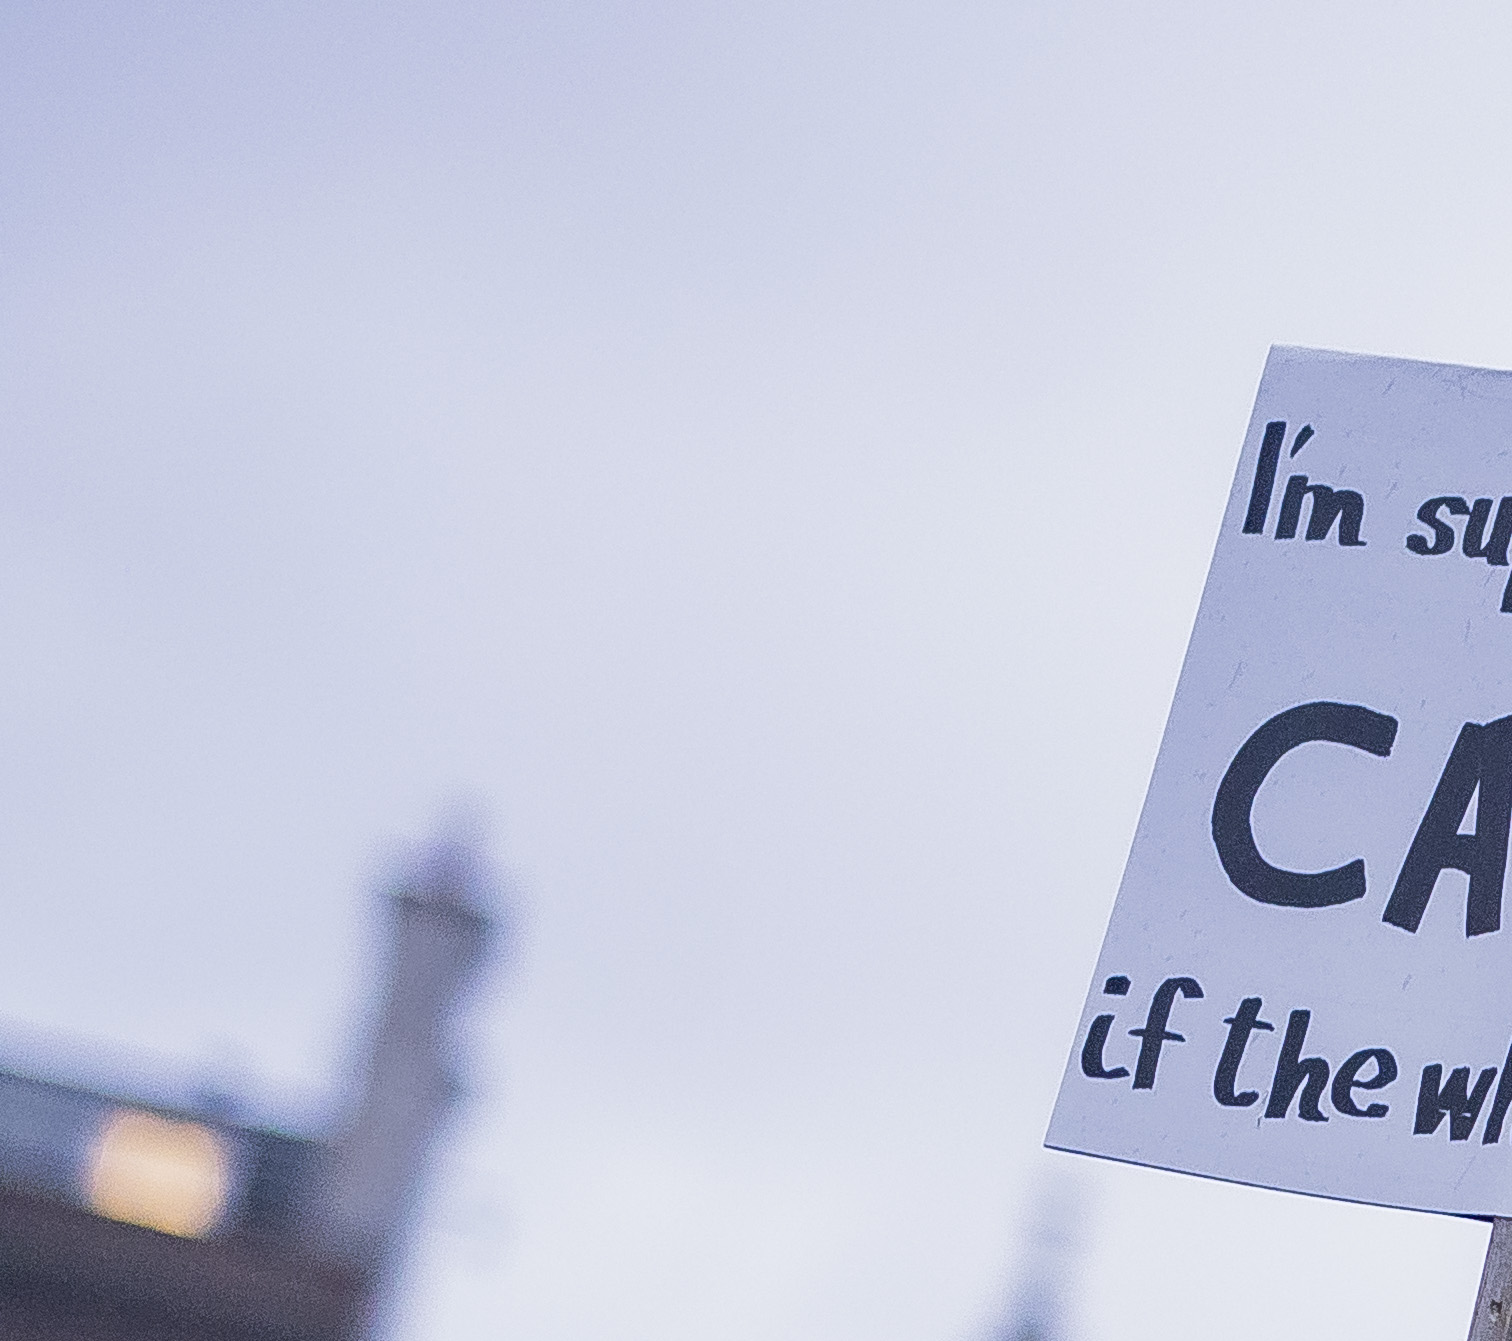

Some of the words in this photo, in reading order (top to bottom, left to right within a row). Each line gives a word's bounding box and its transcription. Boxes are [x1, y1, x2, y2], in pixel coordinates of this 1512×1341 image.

[1241, 420, 1367, 547] I'm
[1081, 974, 1204, 1090] if
[1213, 996, 1399, 1122] the
